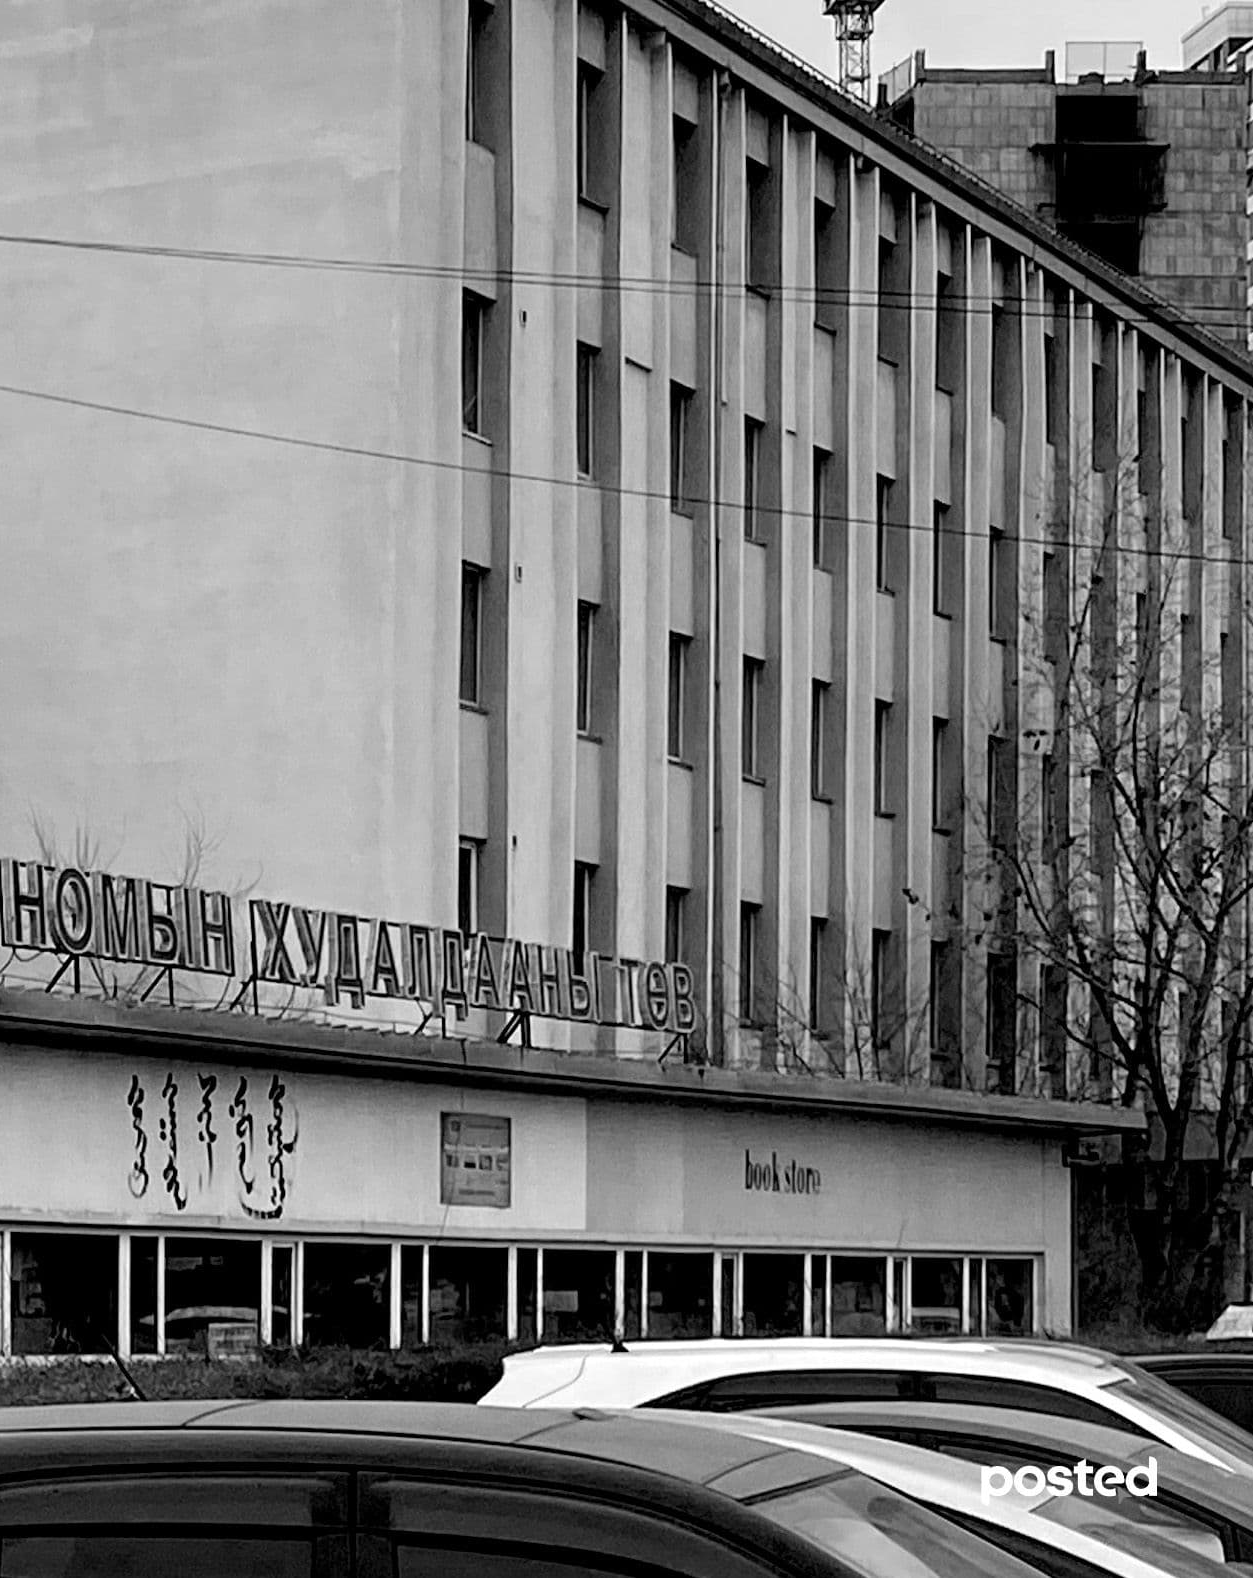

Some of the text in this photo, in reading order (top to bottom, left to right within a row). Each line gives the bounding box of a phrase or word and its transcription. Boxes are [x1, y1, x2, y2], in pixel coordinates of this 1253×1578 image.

[248, 899, 601, 1024] ХУДАЛДААНЫ
[614, 957, 696, 1034] ТӨВ
[745, 1149, 821, 1195] book store
